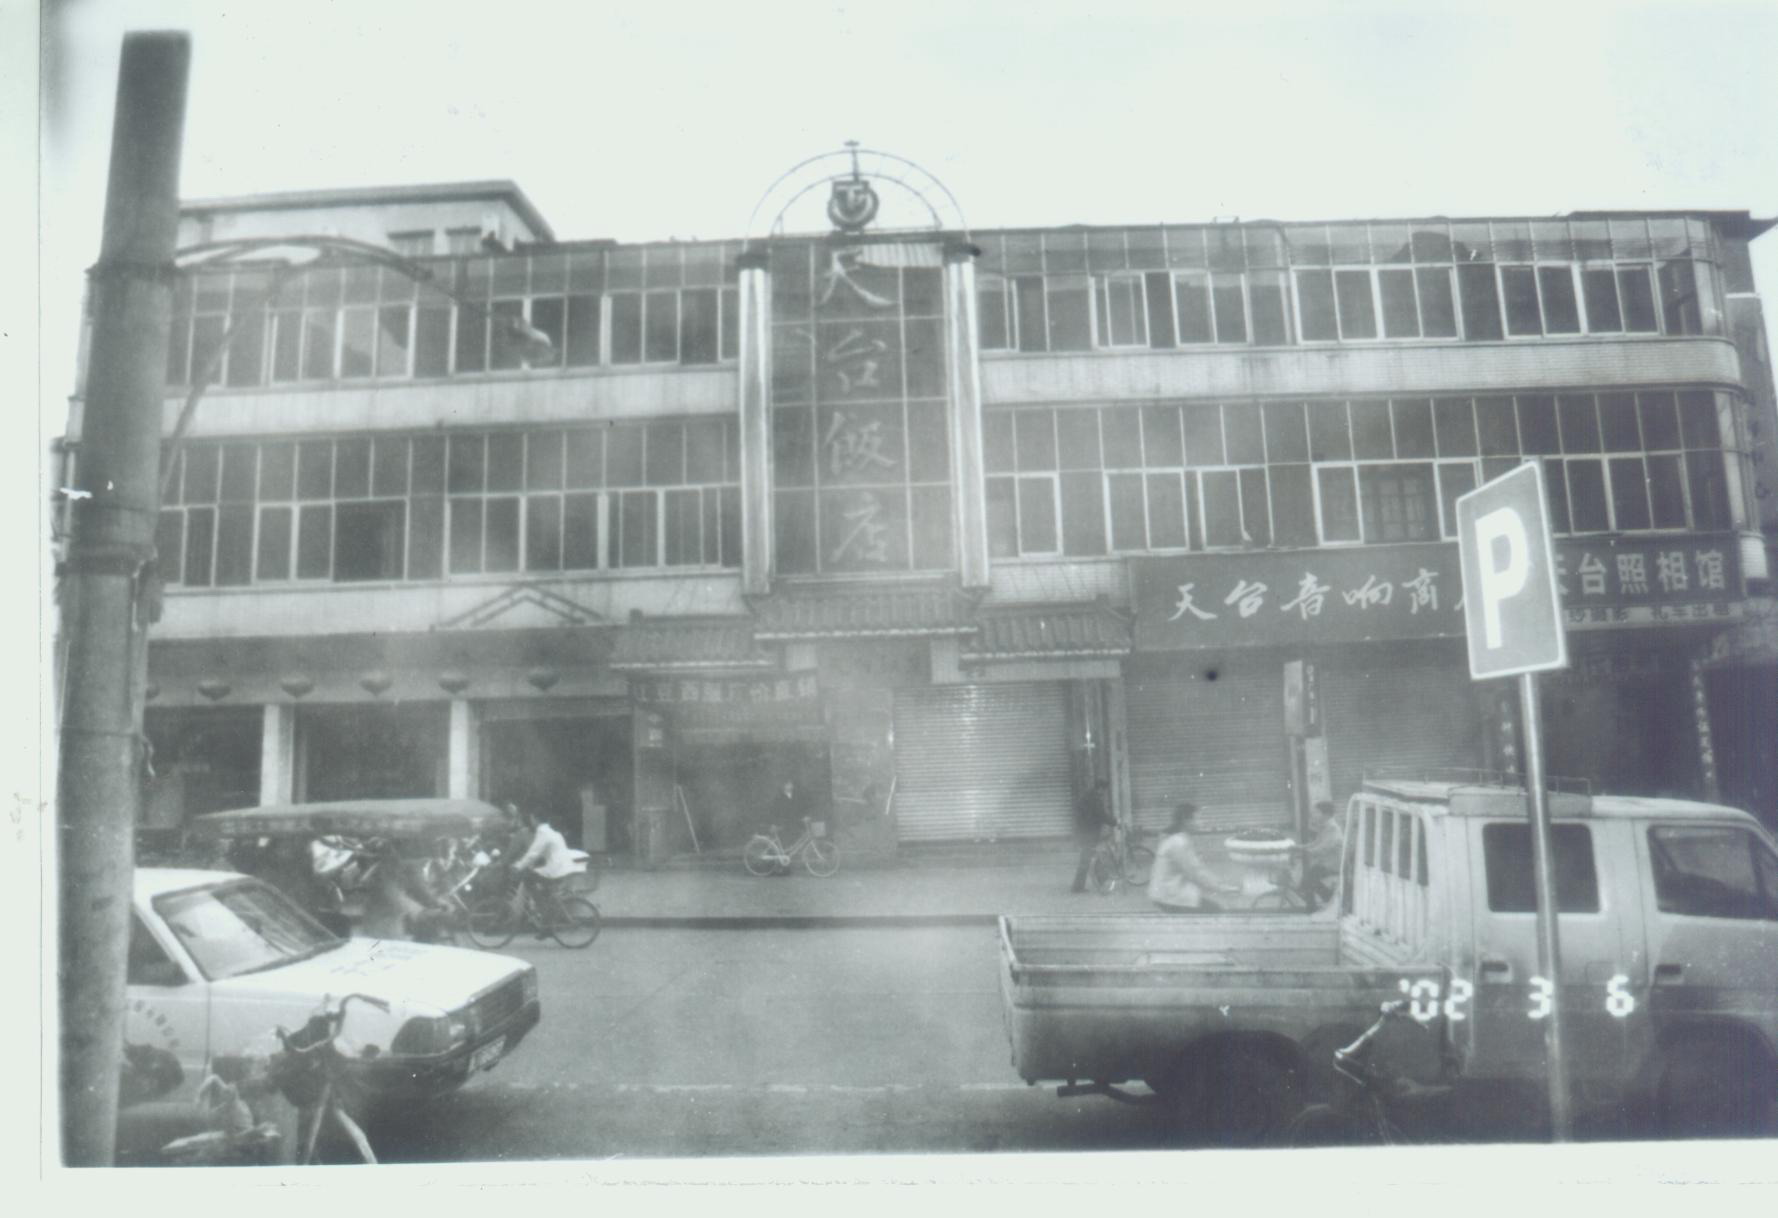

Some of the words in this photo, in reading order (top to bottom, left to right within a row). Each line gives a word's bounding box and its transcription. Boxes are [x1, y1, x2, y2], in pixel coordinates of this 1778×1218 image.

[1166, 566, 1464, 622] 天台音响商
[1474, 505, 1528, 650] P
